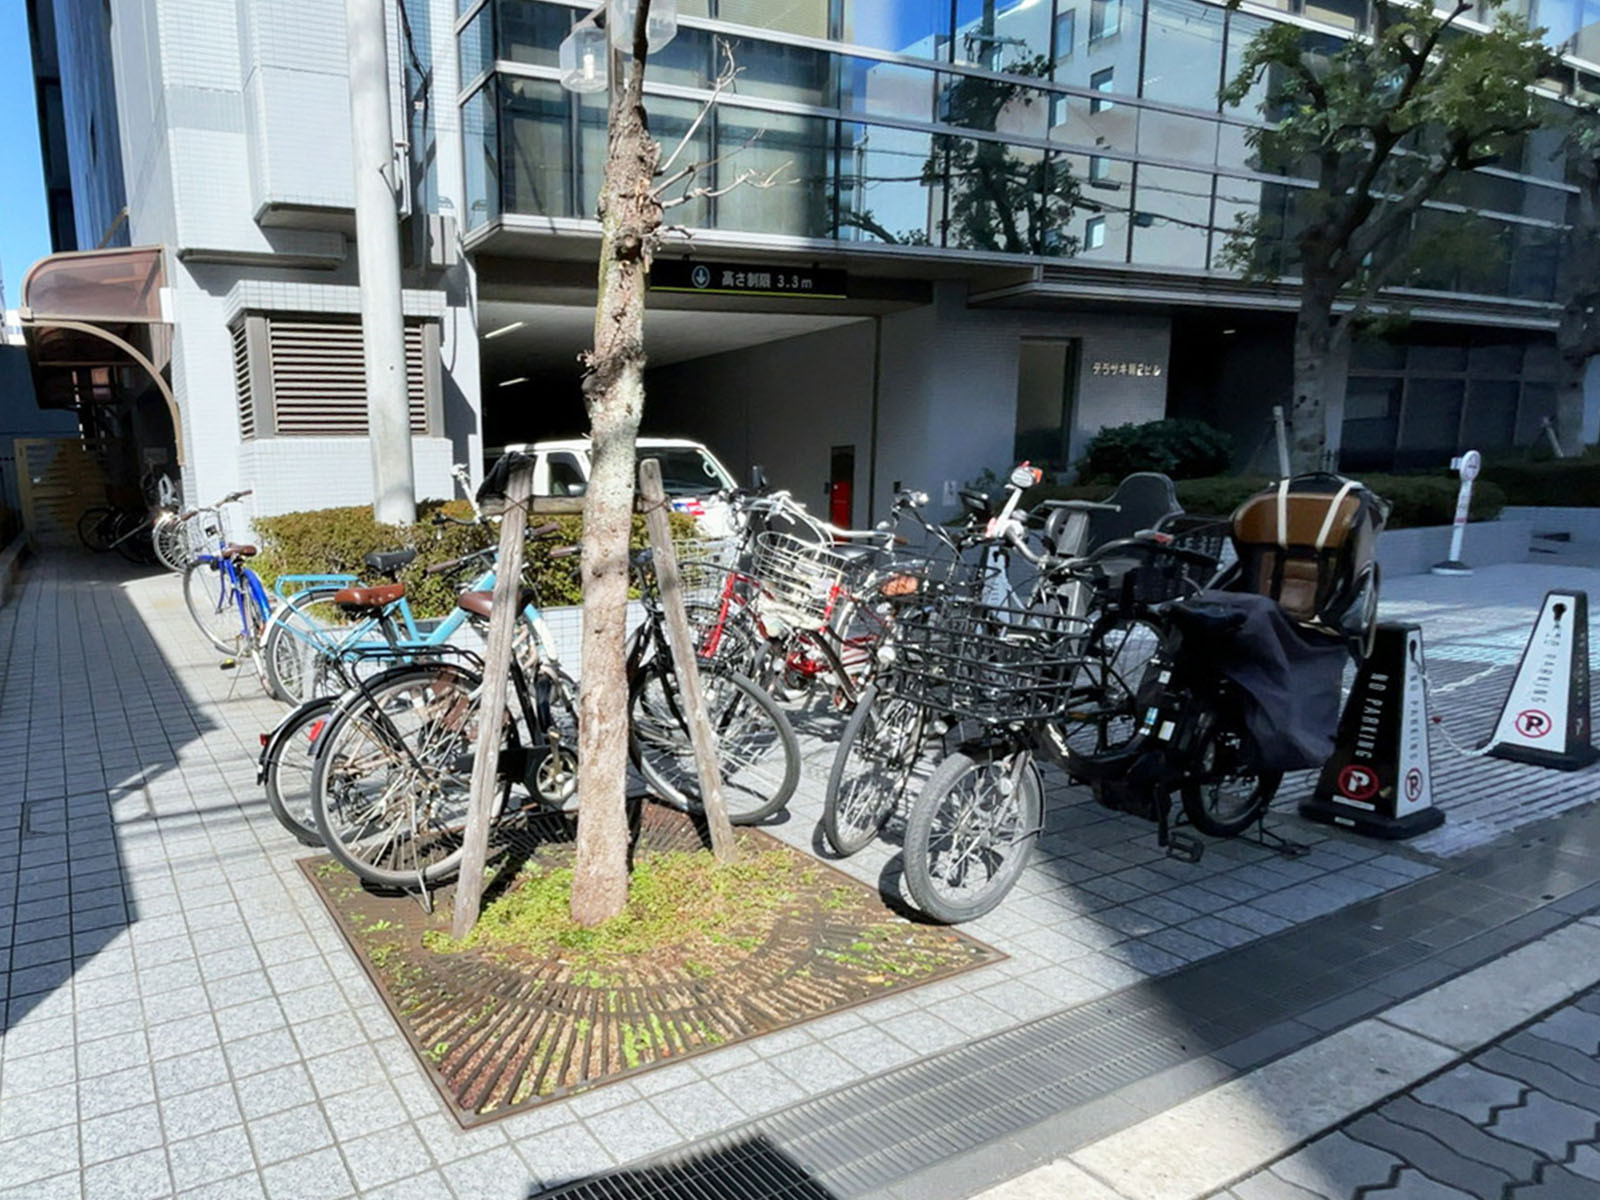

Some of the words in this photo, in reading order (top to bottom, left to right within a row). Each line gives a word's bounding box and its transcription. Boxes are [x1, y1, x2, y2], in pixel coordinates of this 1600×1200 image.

[721, 270, 771, 287] 高さ制限
[1369, 673, 1389, 692] NO
[1355, 698, 1383, 758] PARKING
